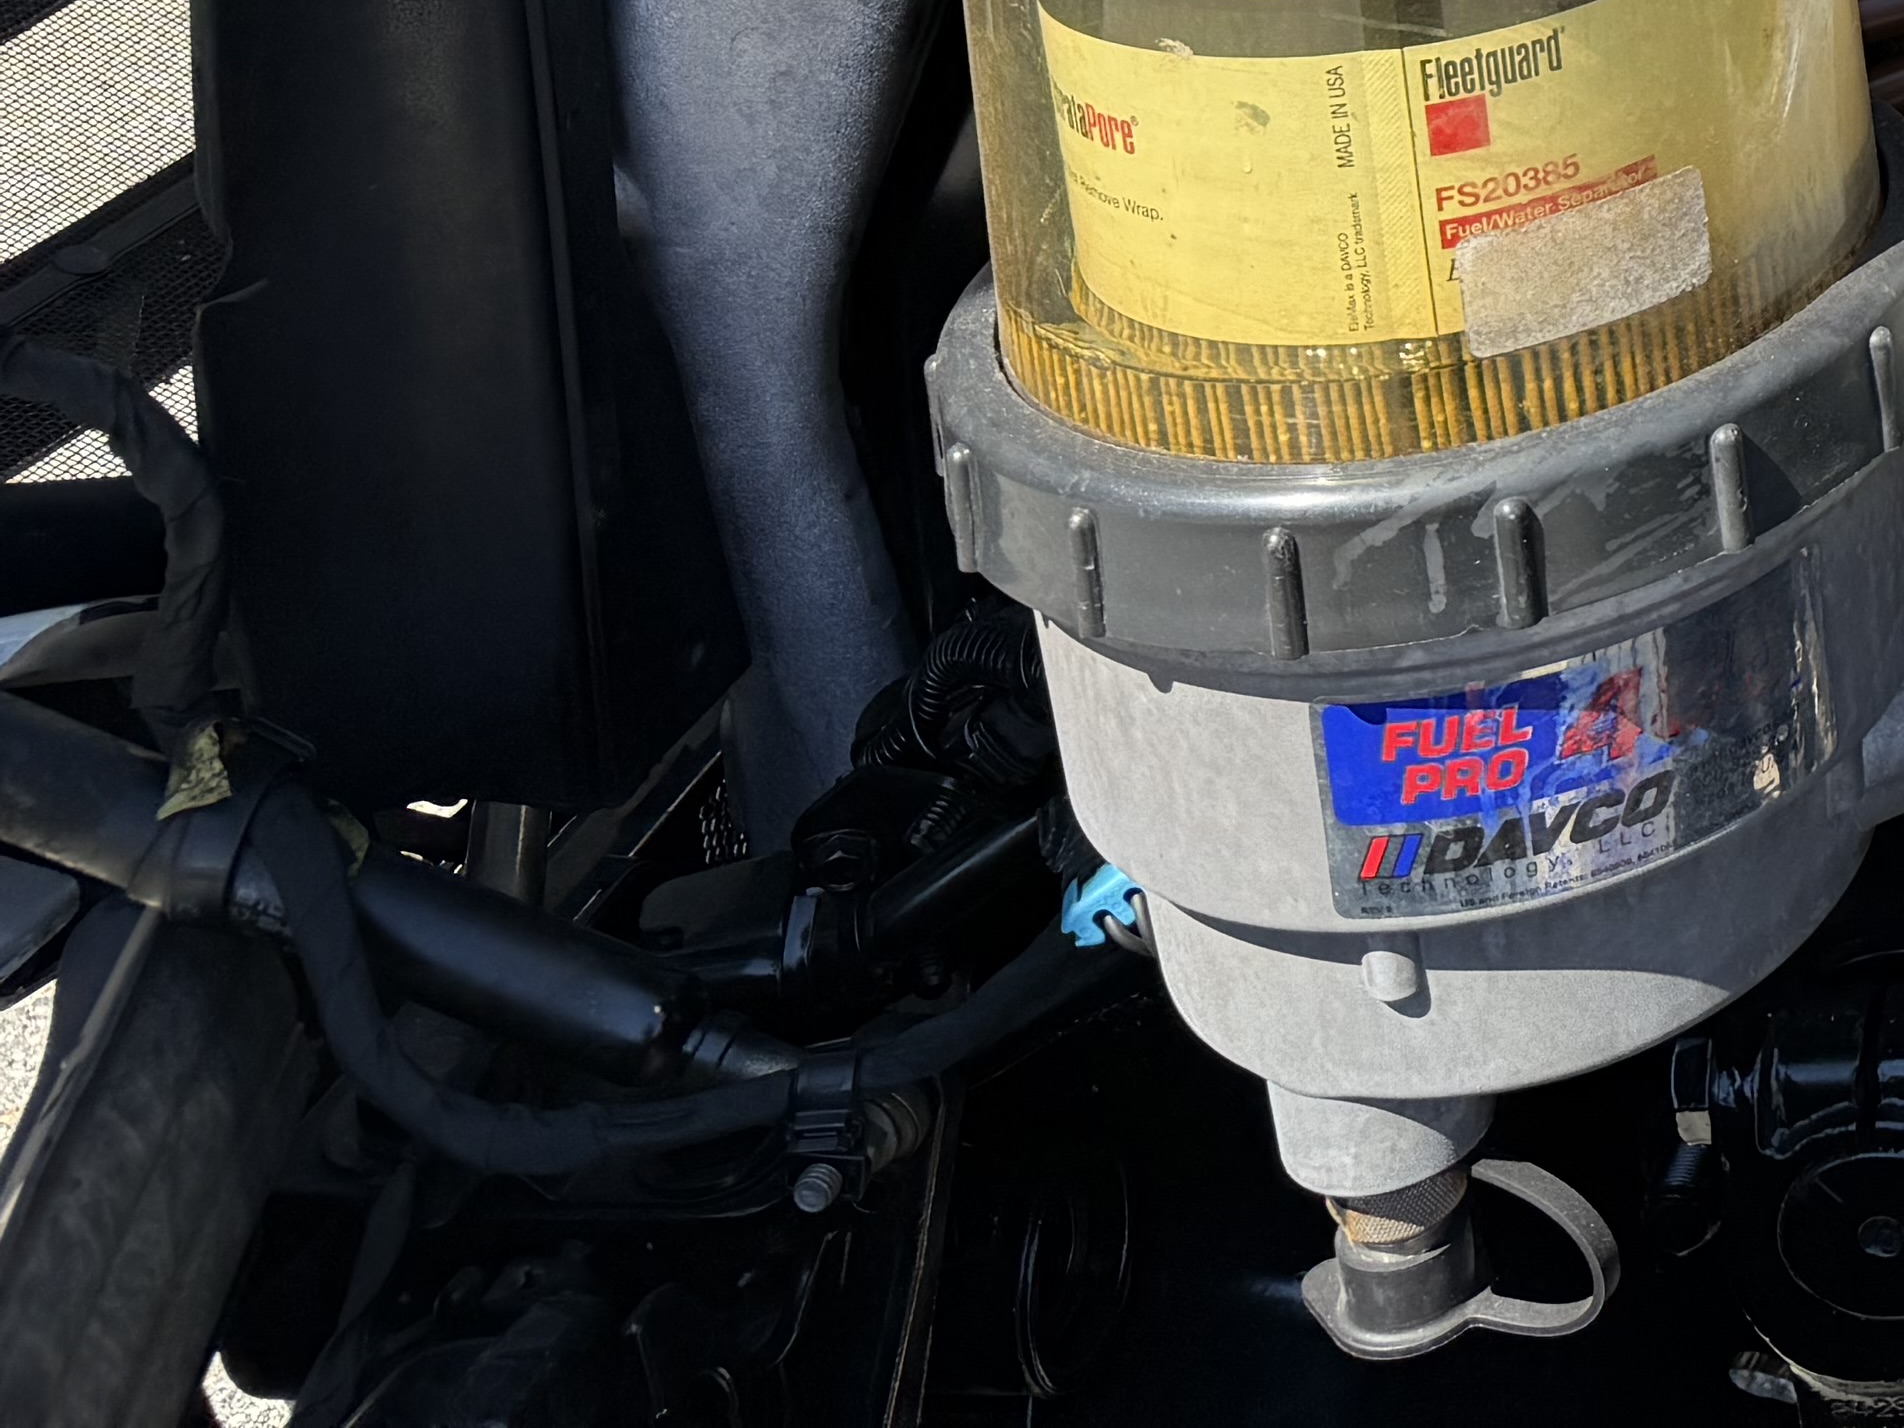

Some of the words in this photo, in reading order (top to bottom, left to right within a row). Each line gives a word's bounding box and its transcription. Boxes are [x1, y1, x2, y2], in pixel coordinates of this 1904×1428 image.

[1326, 65, 1345, 100] USA
[1420, 28, 1562, 102] Fleetguard
[1330, 102, 1349, 120] IN
[1331, 123, 1355, 168] MADE
[1435, 153, 1580, 212] FS20385
[1122, 196, 1164, 222] Wrap.
[1445, 201, 1553, 240] Fuel/Water
[1355, 247, 1368, 269] LLC
[1382, 705, 1533, 762] FUEL
[1401, 748, 1530, 805] PRO
[1424, 770, 1675, 875] DAVCO
[1598, 819, 1656, 854] LLC
